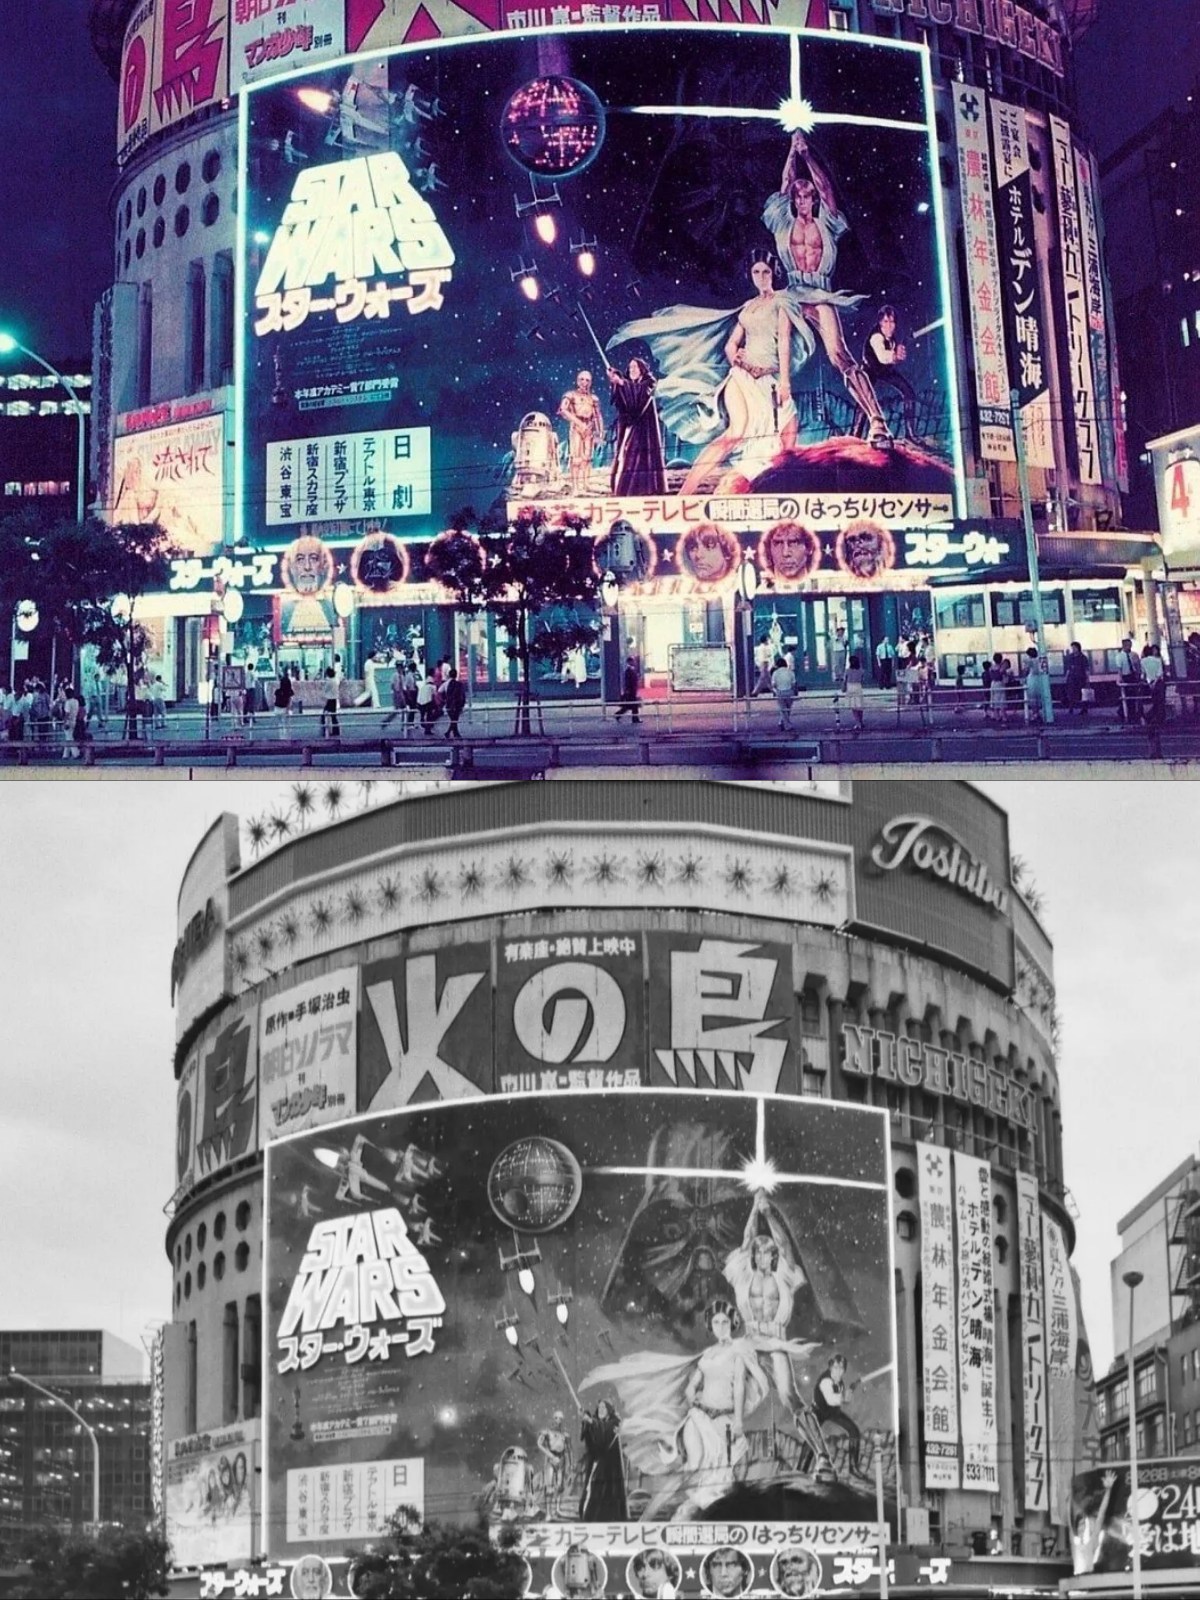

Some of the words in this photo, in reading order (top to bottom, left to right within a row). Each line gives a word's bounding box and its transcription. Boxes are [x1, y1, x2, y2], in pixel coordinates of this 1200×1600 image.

[280, 151, 424, 226] STAR
[255, 201, 456, 298] WARS
[391, 434, 413, 510] 日劇
[299, 1207, 420, 1274] STAR
[277, 1254, 446, 1337] WARS
